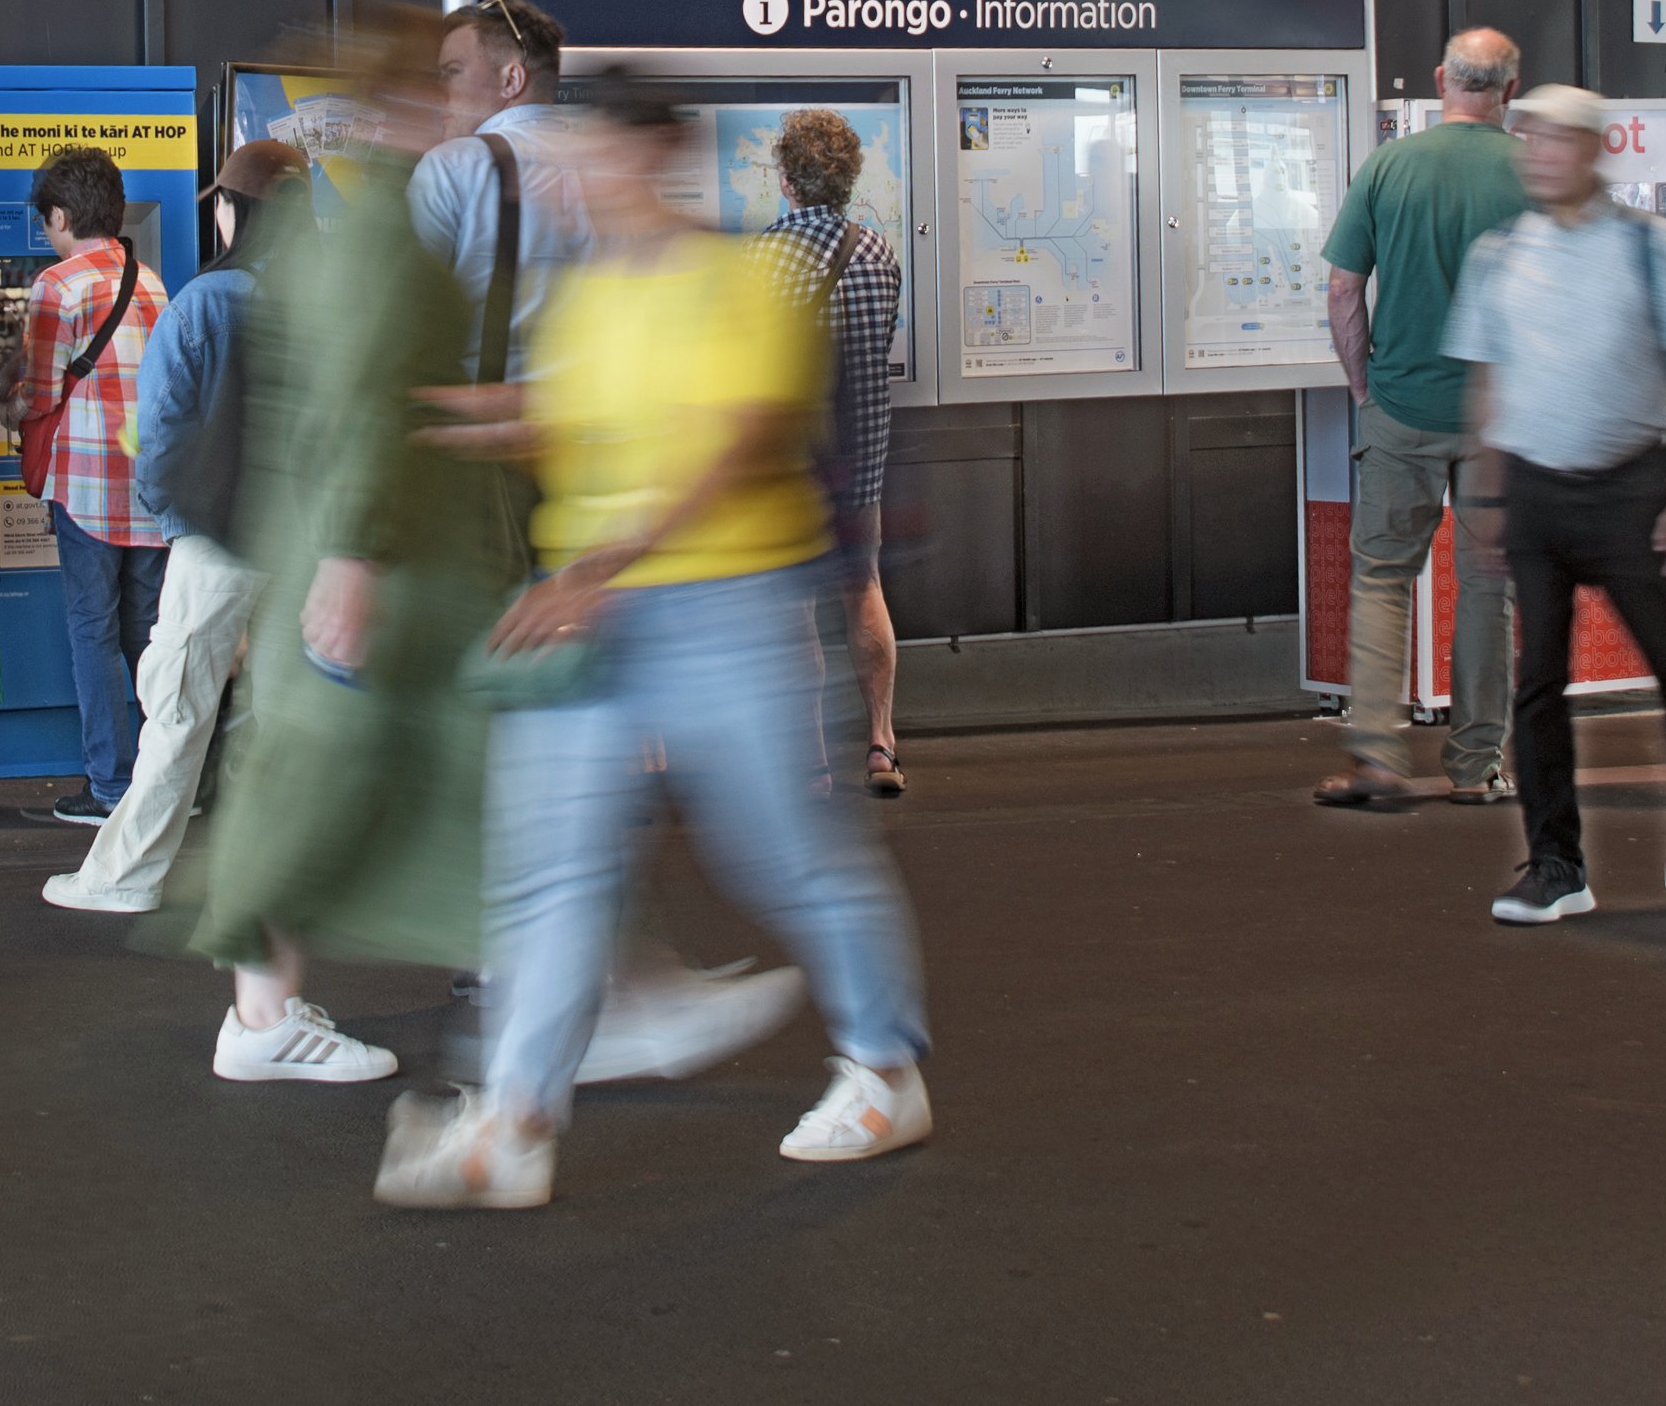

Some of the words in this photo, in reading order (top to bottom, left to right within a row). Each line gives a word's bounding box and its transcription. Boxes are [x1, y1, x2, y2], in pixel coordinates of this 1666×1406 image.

[959, 86, 992, 95] Auckland
[993, 86, 1012, 96] Ferry
[1013, 86, 1043, 95] Network
[1181, 85, 1217, 93] Downtown
[1218, 85, 1236, 95] Ferry
[1237, 85, 1266, 93] Terminal
[0, 124, 20, 138] he
[23, 124, 61, 138] moni
[64, 124, 78, 138] ki
[81, 125, 97, 138] te
[100, 125, 129, 139] kāri
[132, 125, 152, 139] AT
[154, 125, 187, 139] HOP
[18, 144, 37, 157] AT
[41, 144, 73, 157] HOP
[15, 502, 46, 510] at.govt.n
[16, 518, 26, 526] 09
[26, 517, 40, 525] 366
